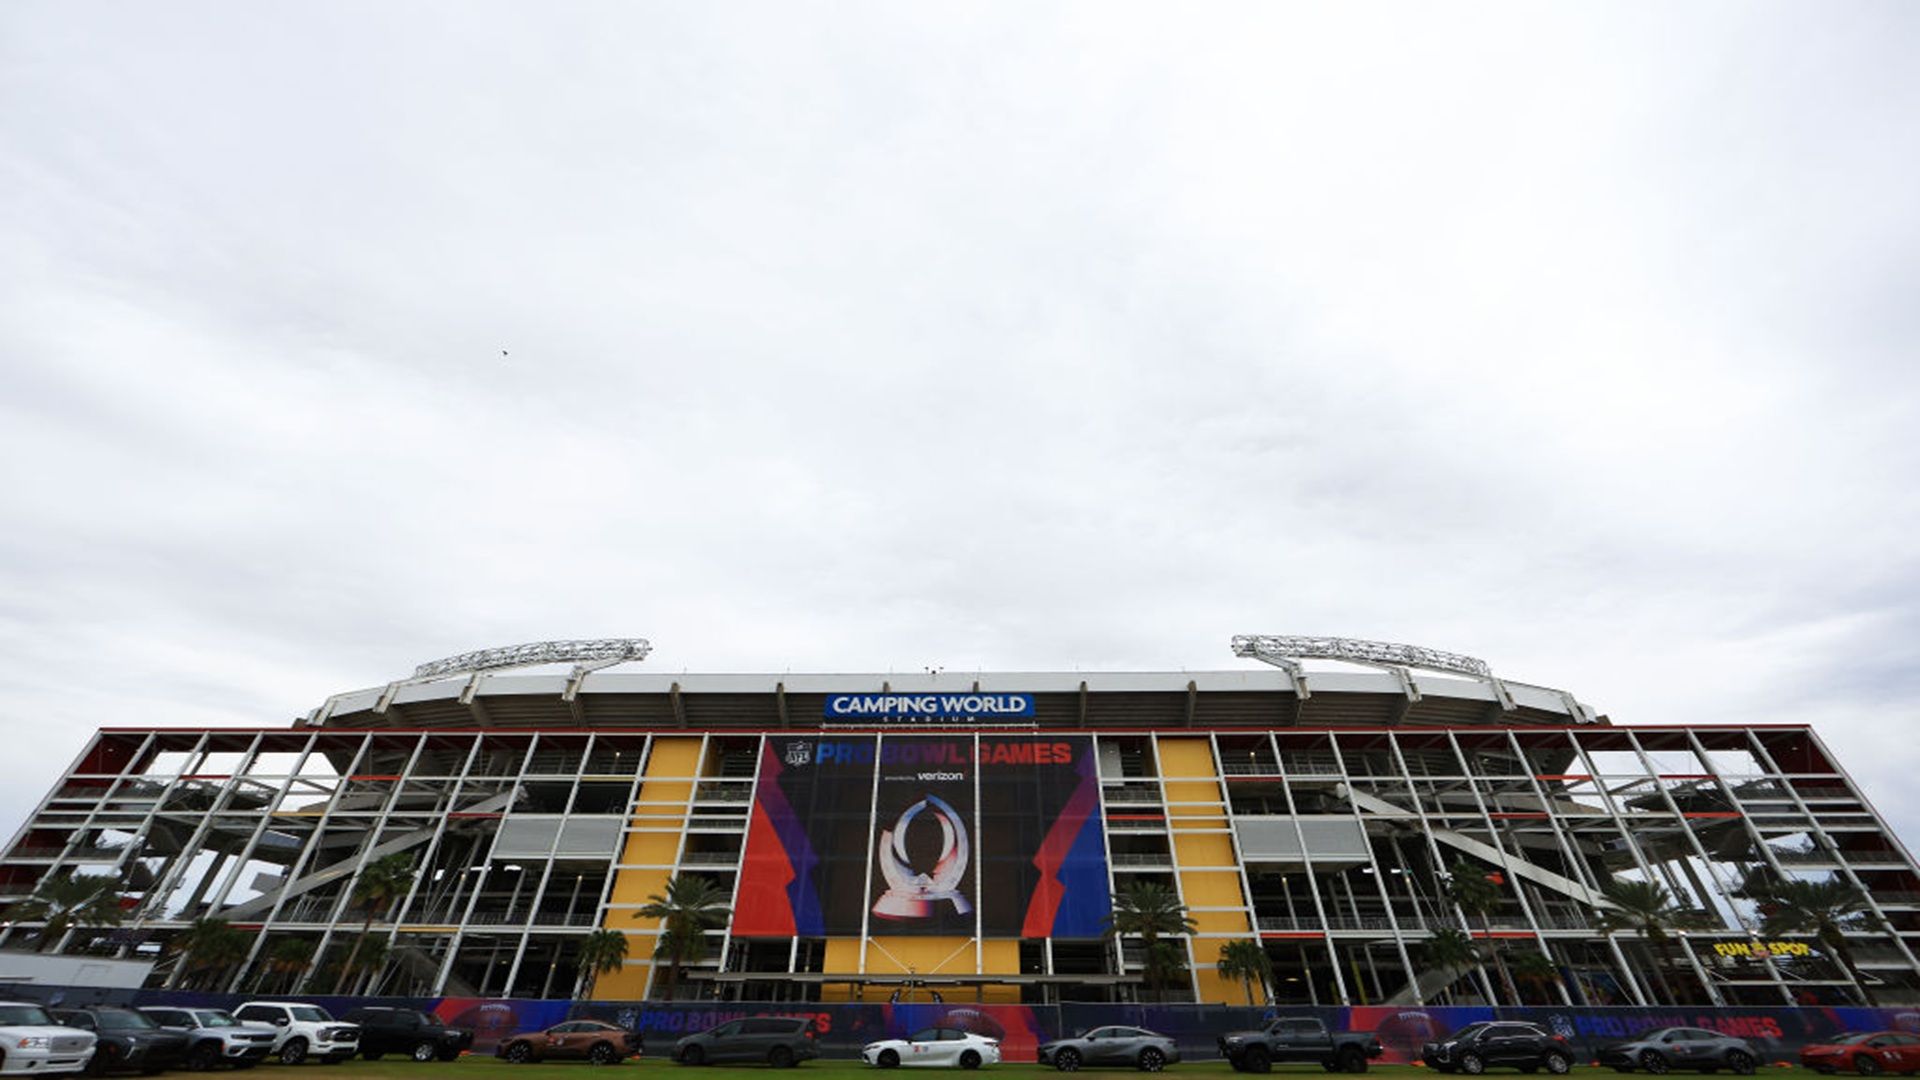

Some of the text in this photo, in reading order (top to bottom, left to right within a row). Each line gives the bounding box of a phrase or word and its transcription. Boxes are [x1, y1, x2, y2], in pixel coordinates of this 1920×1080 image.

[833, 696, 1026, 713] CAMPING WORLD
[816, 742, 1072, 765] PRO BOWL GAMES
[917, 771, 964, 781] verizon
[1713, 942, 1810, 957] FUN SPOT
[640, 1011, 684, 1032] PRO
[1575, 1015, 1626, 1037] PRO
